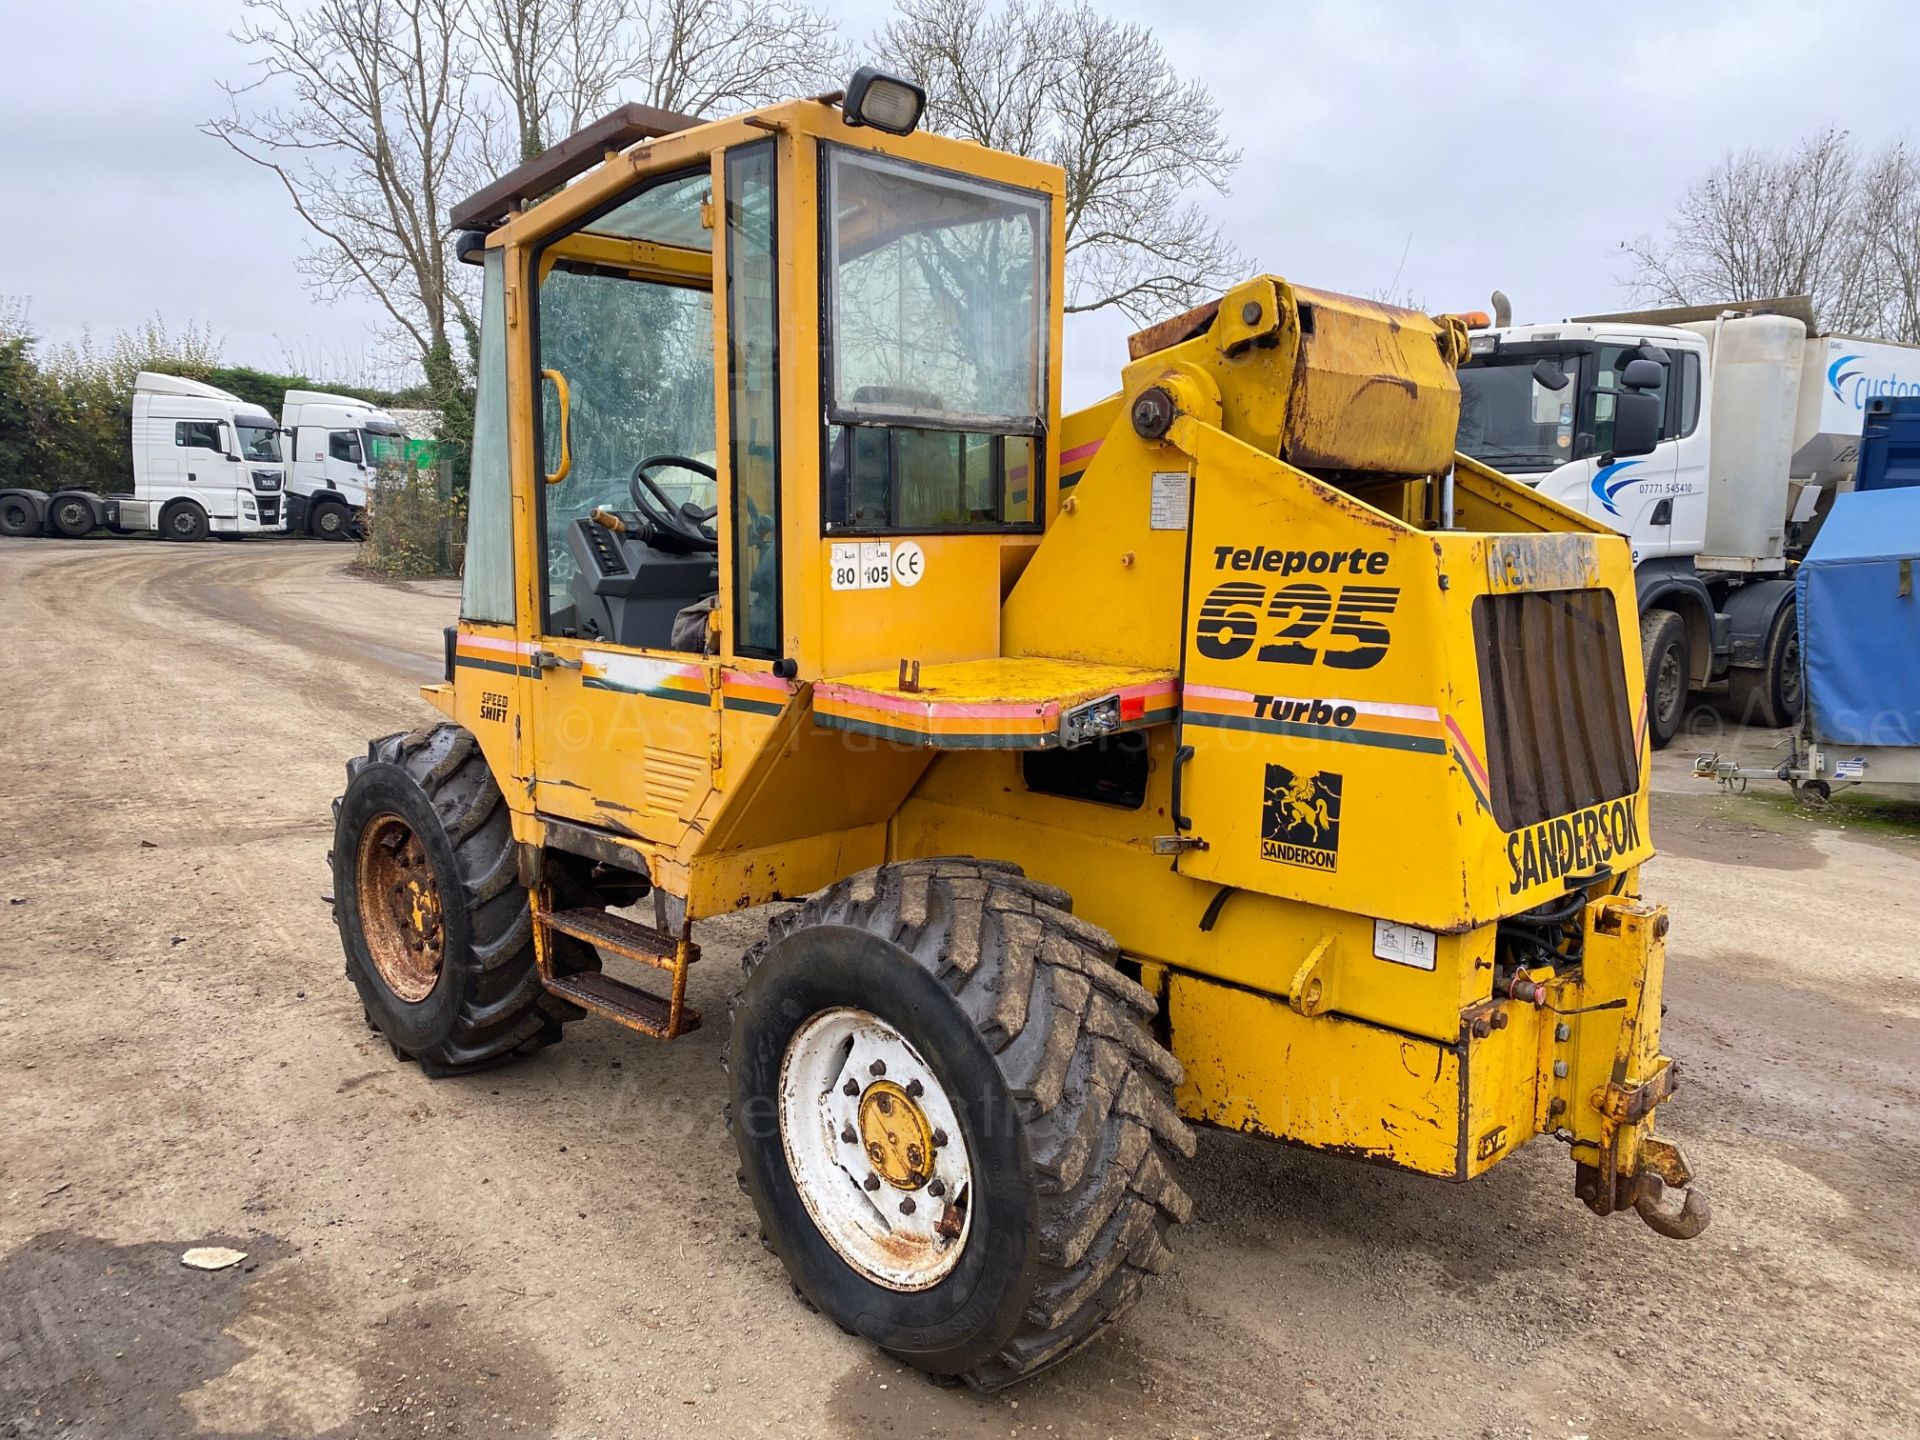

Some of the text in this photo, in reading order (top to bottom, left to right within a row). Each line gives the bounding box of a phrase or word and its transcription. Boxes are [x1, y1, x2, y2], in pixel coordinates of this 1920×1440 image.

[1639, 482, 1693, 494] 07771 545410
[1213, 545, 1390, 577] Teleporte
[837, 568, 855, 585] 80
[1196, 581, 1401, 670] 625
[480, 704, 508, 724] SHIFT
[481, 691, 509, 709] SPEED
[1253, 694, 1358, 728] Turbo
[1262, 840, 1337, 869] SANDERSON
[1507, 794, 1641, 896] SANDERSON
